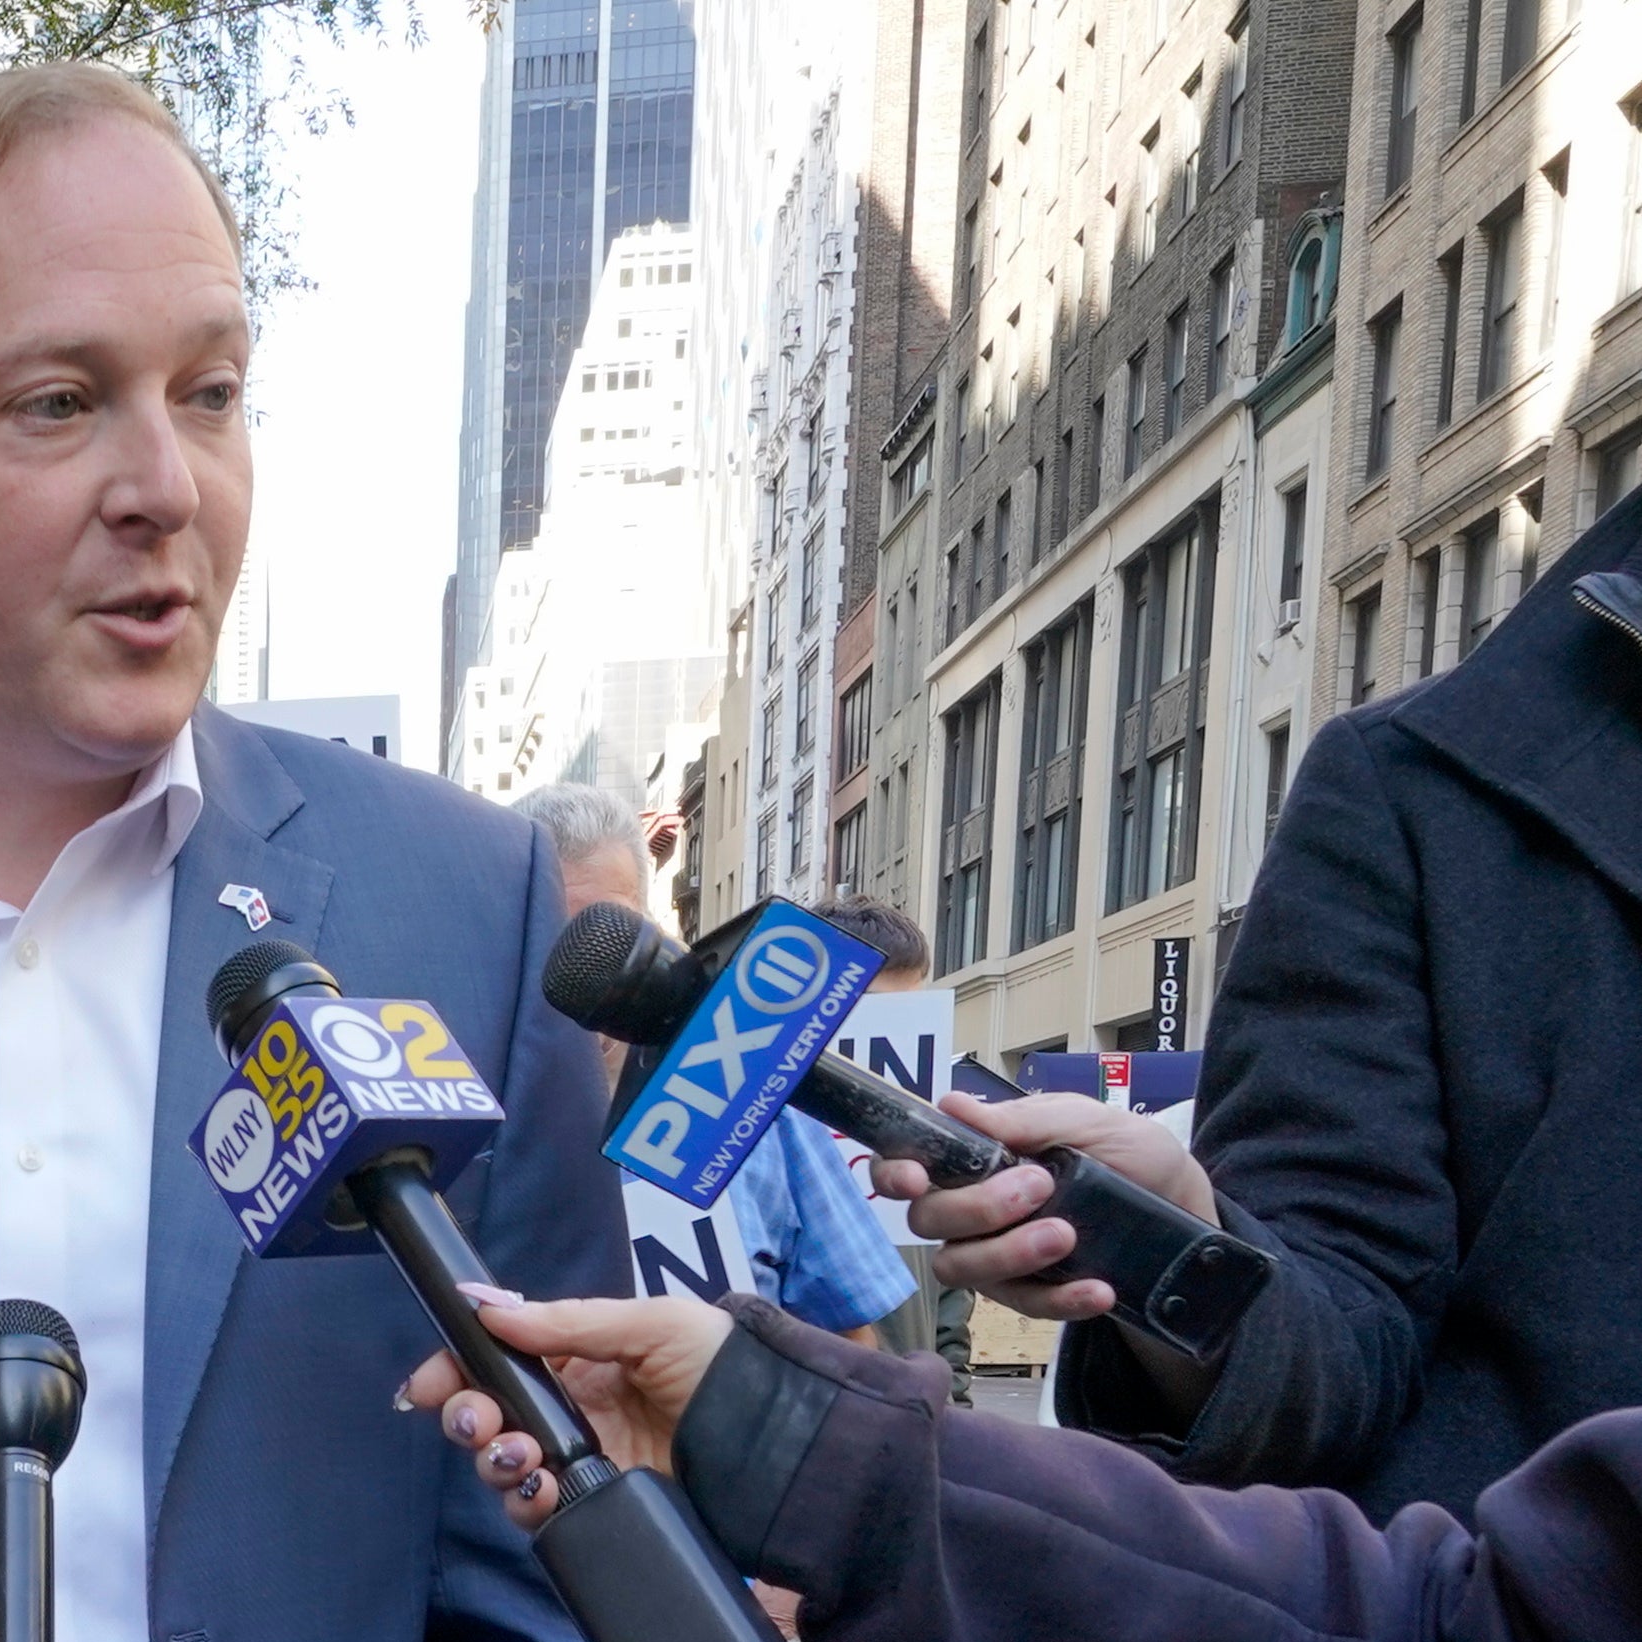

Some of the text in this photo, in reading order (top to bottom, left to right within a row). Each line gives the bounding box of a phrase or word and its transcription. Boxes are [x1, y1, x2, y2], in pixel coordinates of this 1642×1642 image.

[1157, 941, 1179, 1051] LIQUOR
[241, 1020, 298, 1099] 10
[379, 1003, 475, 1079] 2
[691, 961, 867, 1197] NEW YORK'S VERY OWN
[838, 1033, 936, 1103] N
[266, 1046, 326, 1143] 55
[346, 1080, 496, 1113] NEWS
[622, 995, 785, 1180] PIX
[210, 1098, 265, 1180] WLNY
[240, 1091, 351, 1244] NEWS
